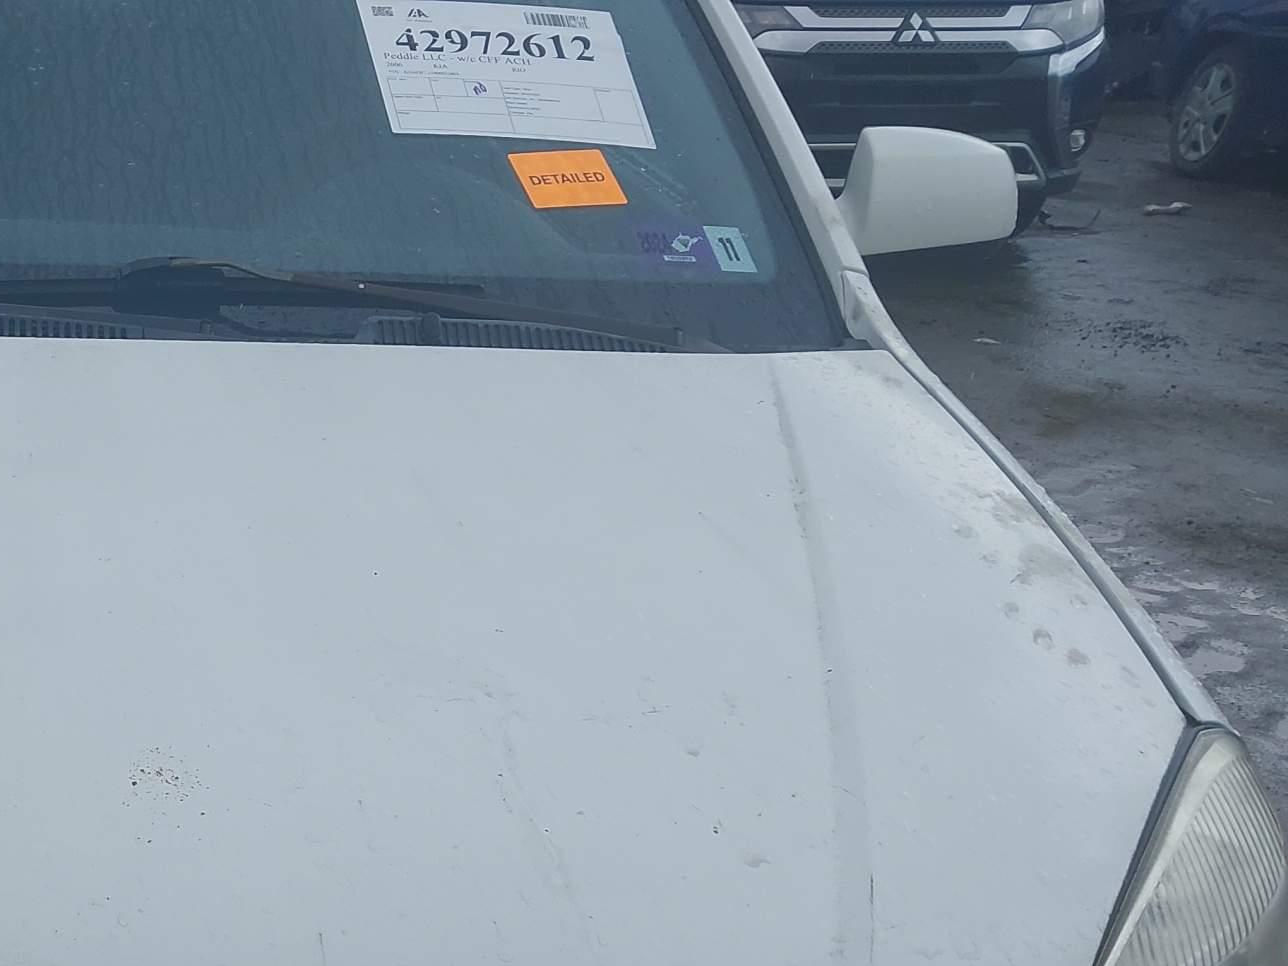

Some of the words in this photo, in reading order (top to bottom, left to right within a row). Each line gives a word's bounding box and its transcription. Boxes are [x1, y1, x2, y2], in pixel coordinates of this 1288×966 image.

[395, 28, 595, 62] 42972612
[384, 52, 419, 61] Peddle
[422, 53, 447, 61] LLC
[529, 171, 605, 186] DETAILED
[718, 237, 741, 262] 11
